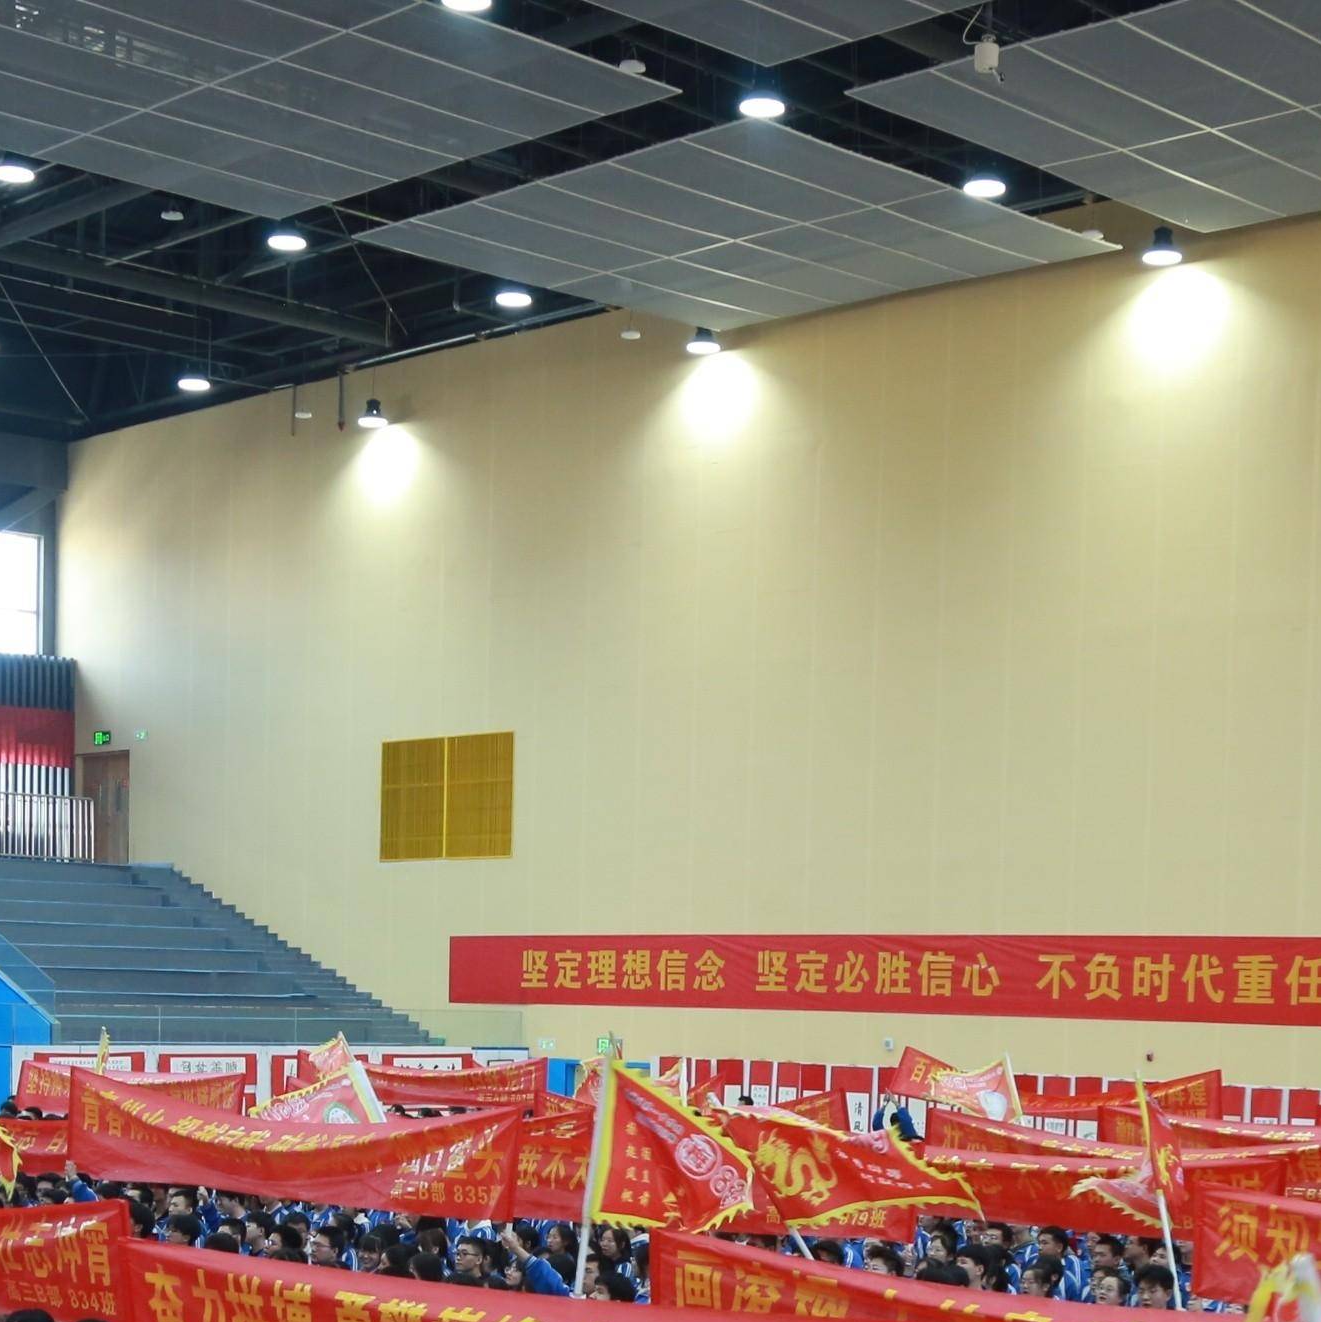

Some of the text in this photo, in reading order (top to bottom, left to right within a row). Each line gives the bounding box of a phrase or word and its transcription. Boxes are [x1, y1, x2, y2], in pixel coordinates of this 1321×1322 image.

[519, 947, 727, 992] 坚定理想信念
[755, 949, 1001, 998] 坚定必胜信心
